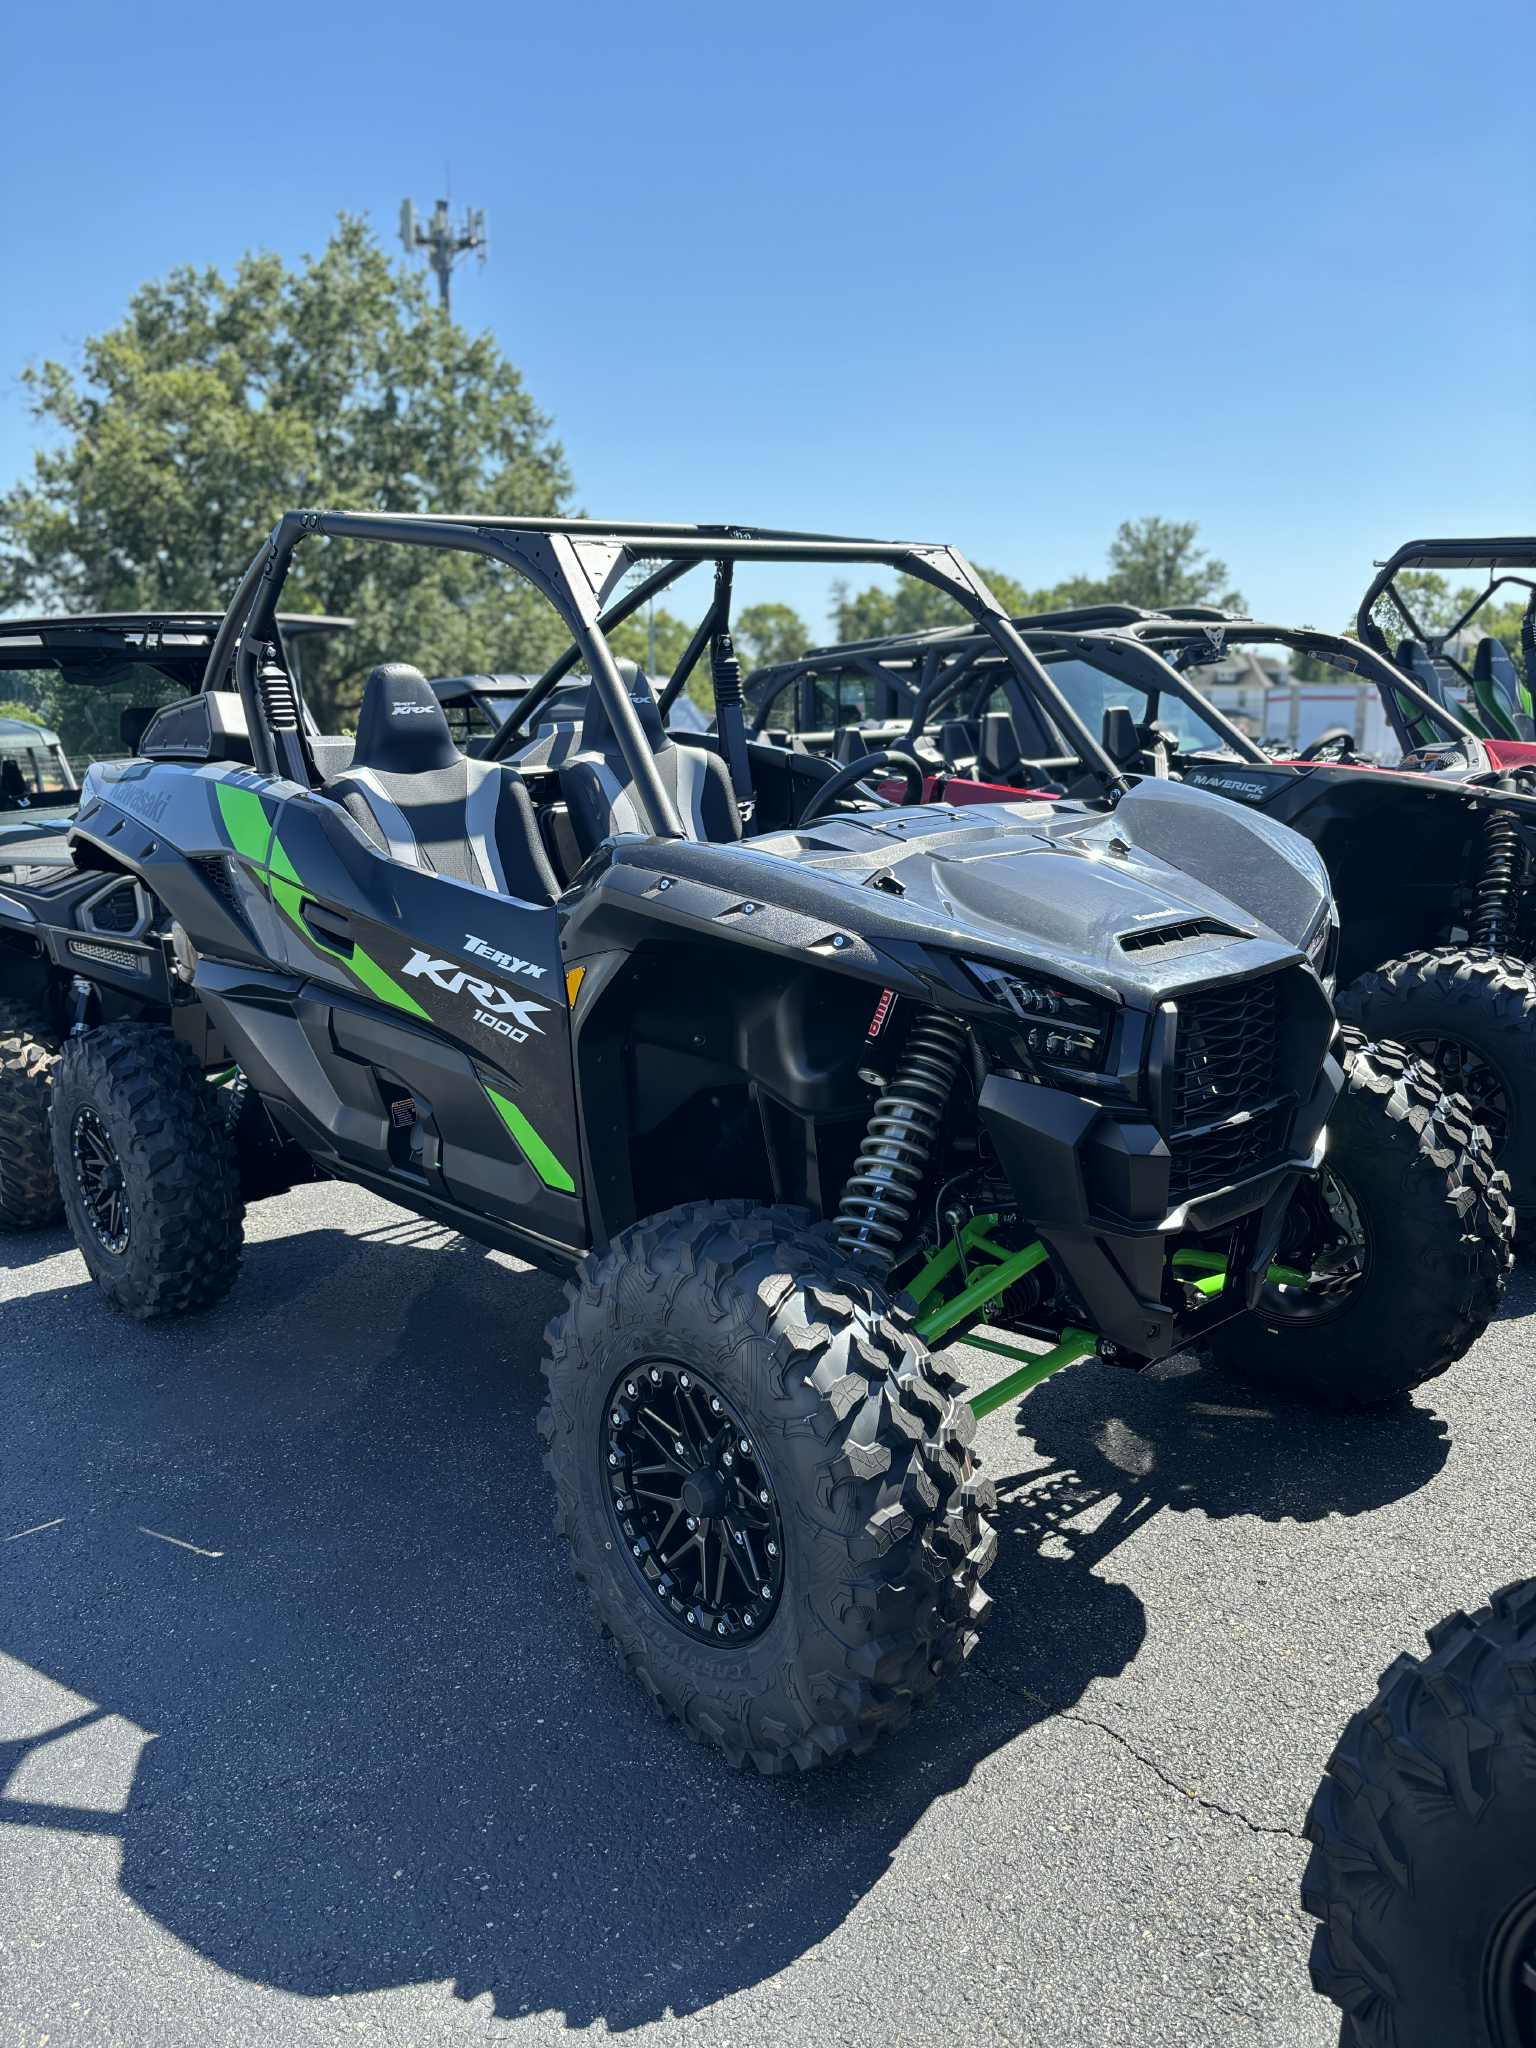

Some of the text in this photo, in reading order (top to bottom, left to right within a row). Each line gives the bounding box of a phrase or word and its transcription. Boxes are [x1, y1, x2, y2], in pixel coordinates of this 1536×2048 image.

[391, 705, 436, 716] KRX
[1193, 774, 1268, 795] MAVERICK
[400, 947, 552, 1036] KRX
[472, 1008, 529, 1044] 1000
